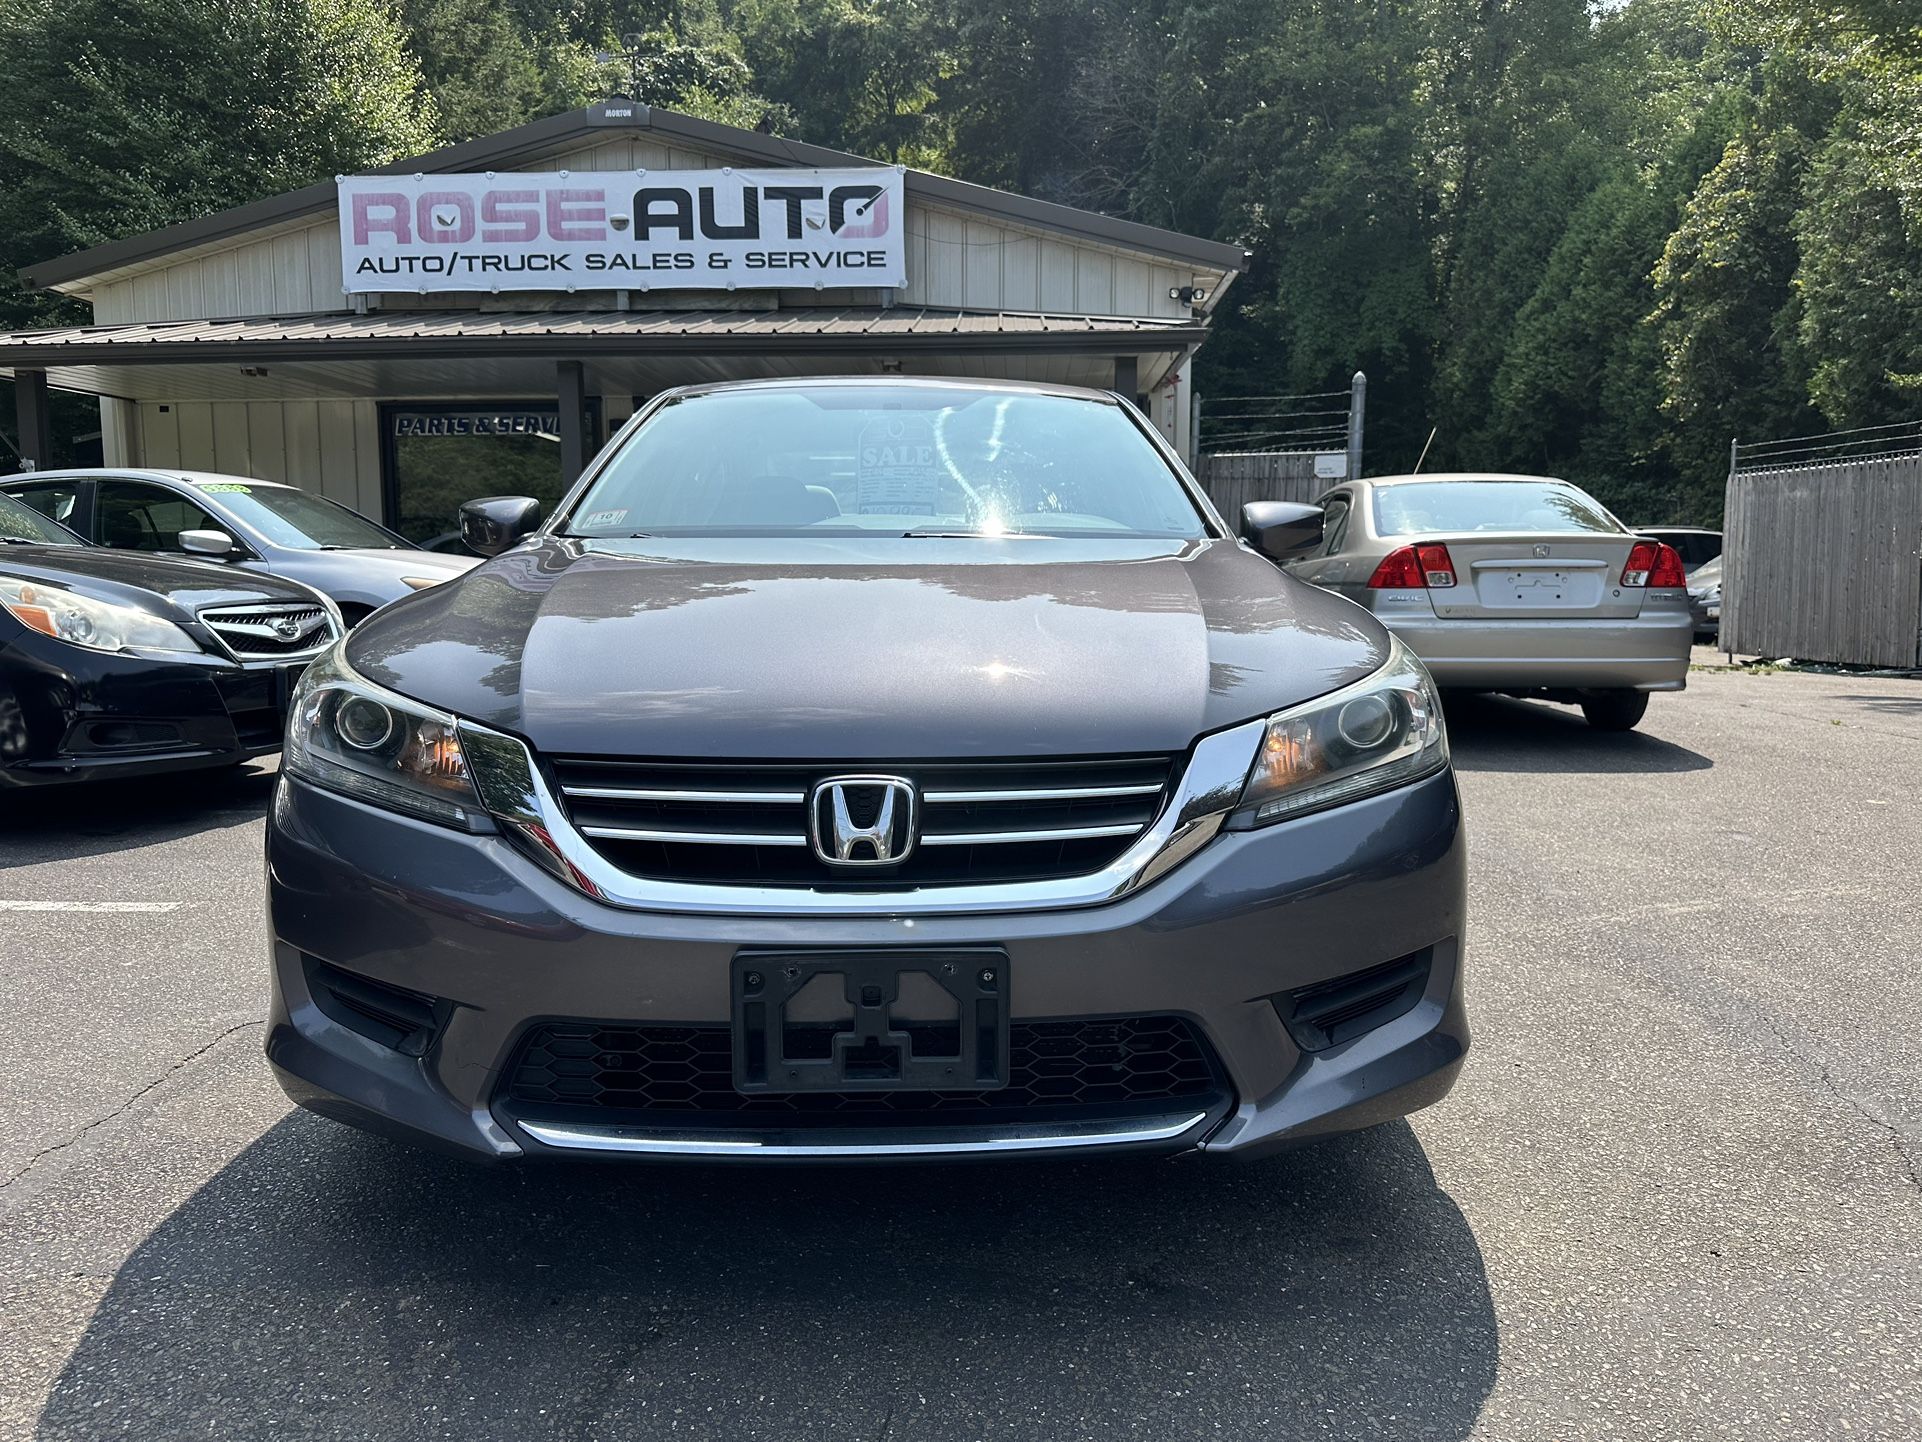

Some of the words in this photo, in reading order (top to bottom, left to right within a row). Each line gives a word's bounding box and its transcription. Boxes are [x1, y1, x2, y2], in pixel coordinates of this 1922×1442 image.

[604, 108, 632, 118] MORTON
[352, 188, 607, 246] ROSE
[633, 185, 889, 241] AUTO
[356, 252, 572, 276] AUTO/TRUCK
[585, 252, 695, 271] SALES
[708, 252, 732, 270] &
[745, 250, 887, 269] SERVICE
[396, 416, 470, 436] PARTS
[473, 417, 491, 435] &
[862, 445, 933, 467] SALE
